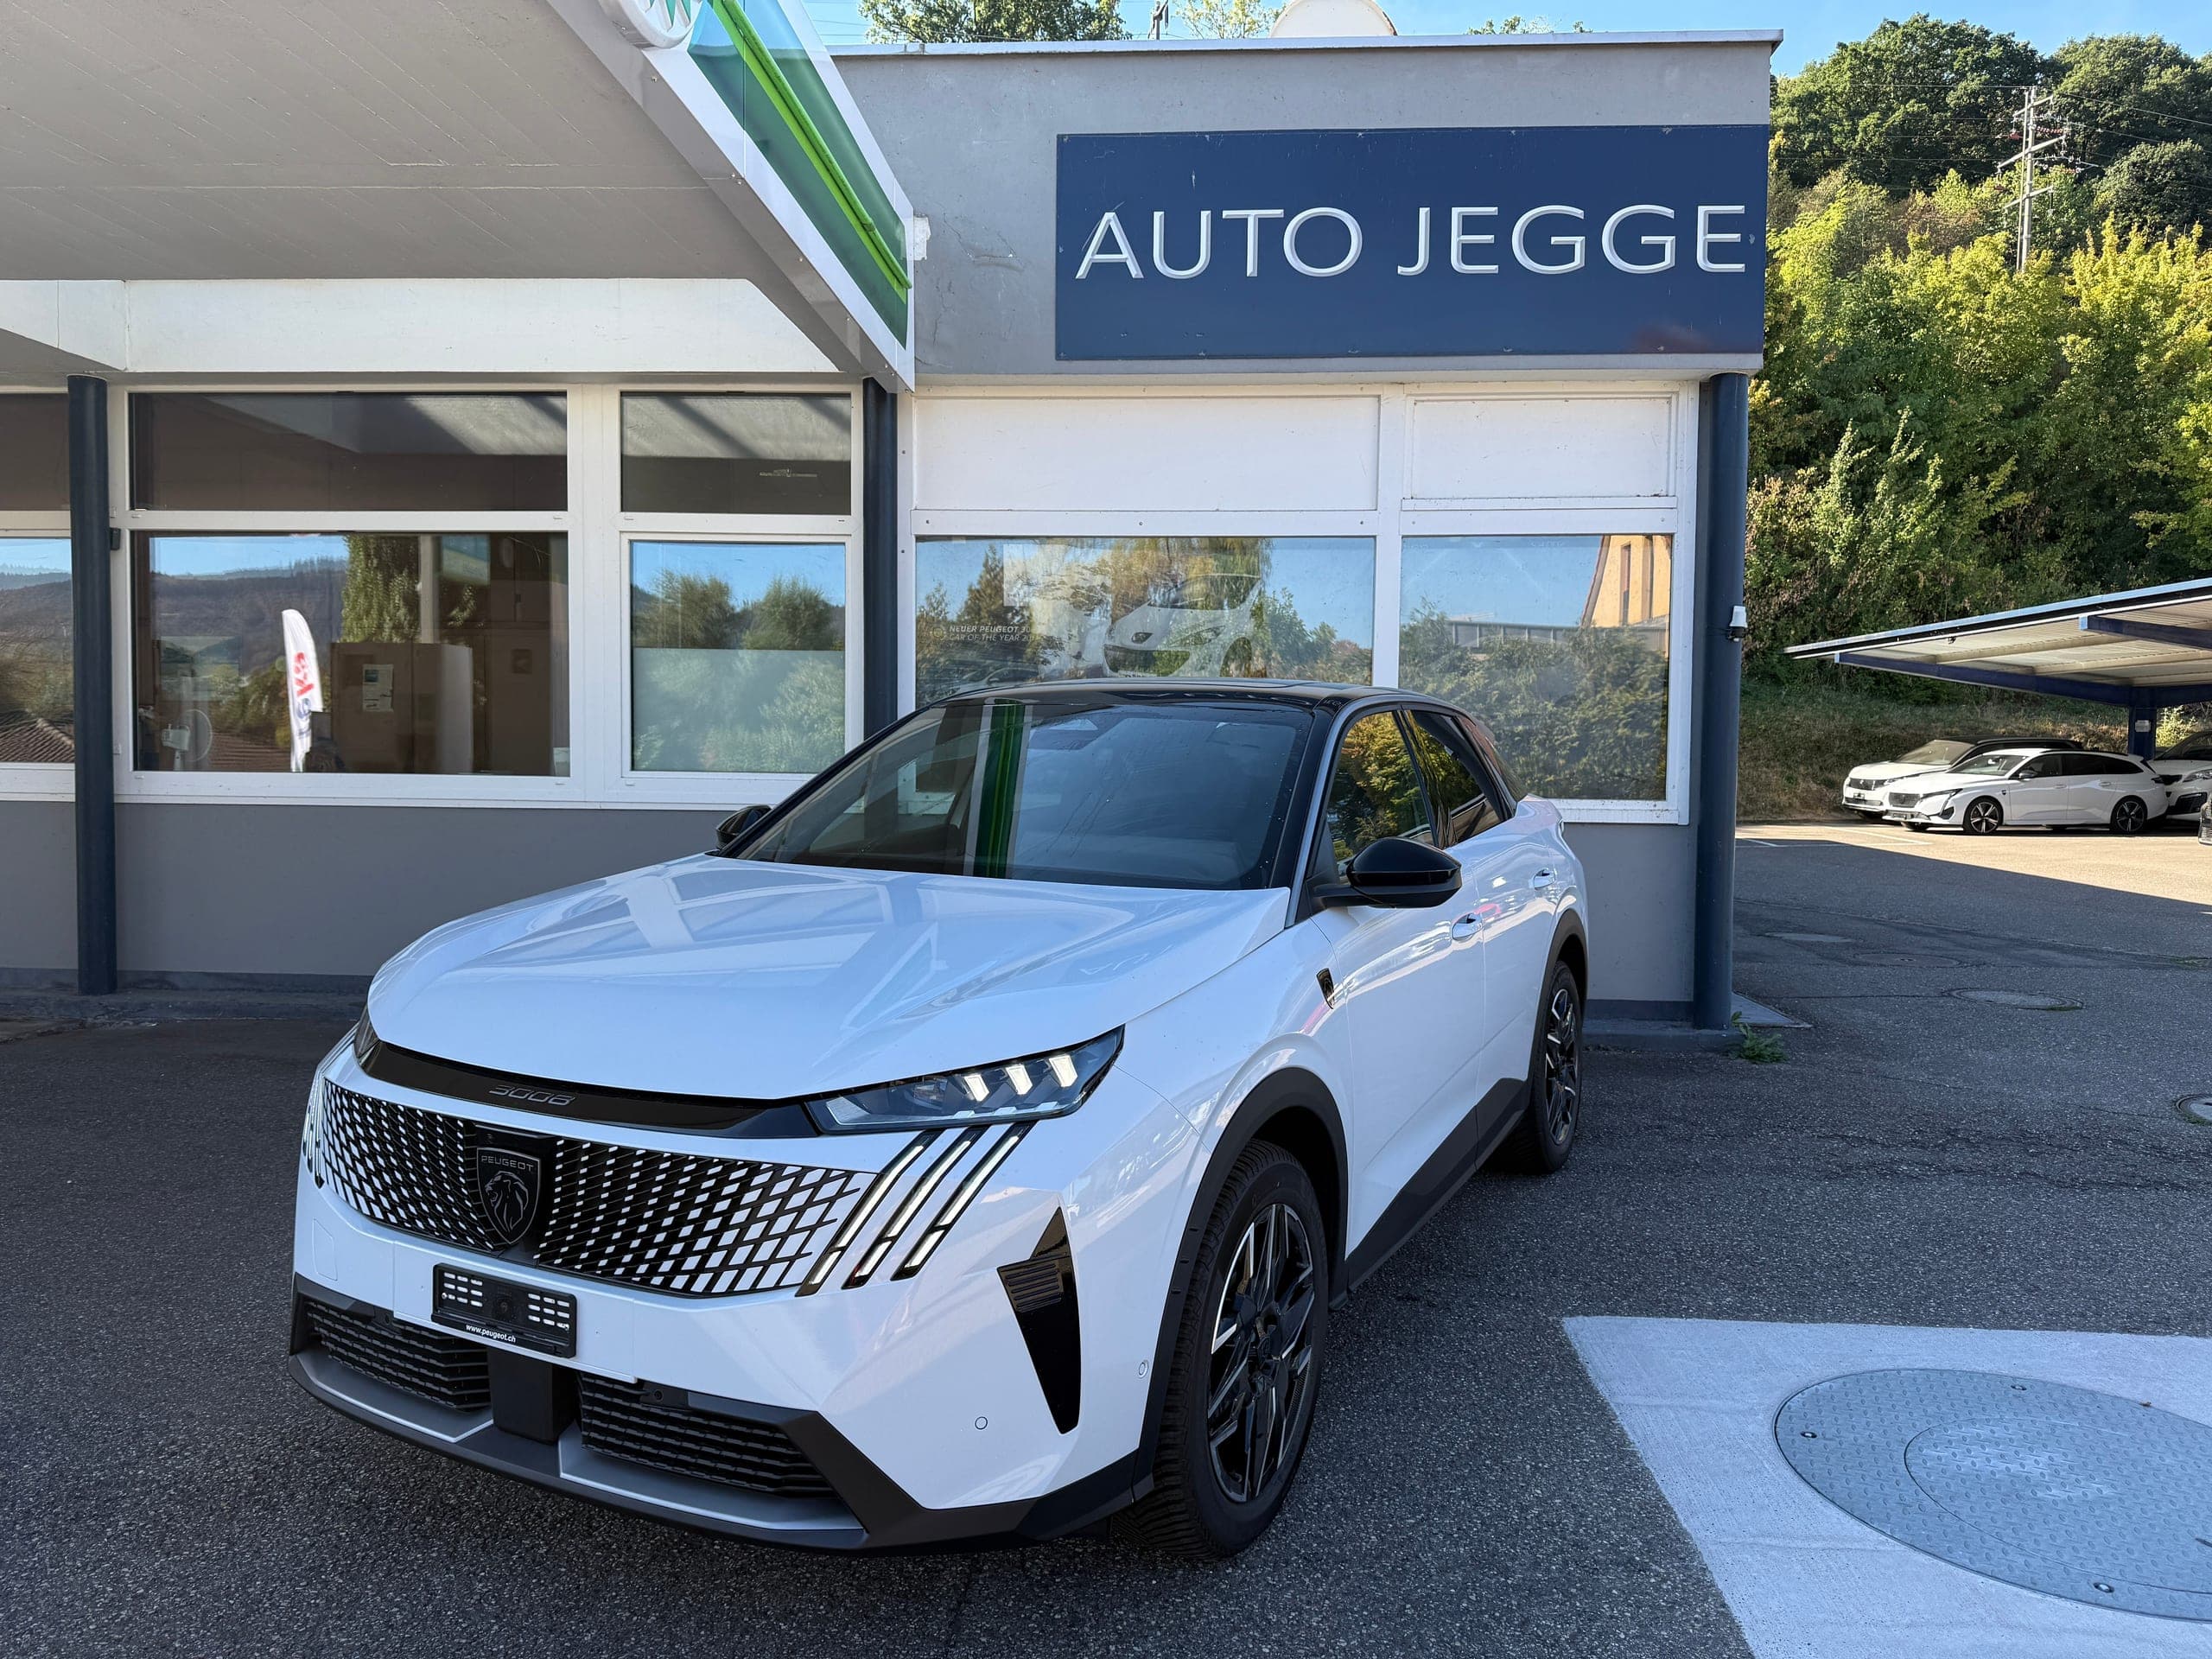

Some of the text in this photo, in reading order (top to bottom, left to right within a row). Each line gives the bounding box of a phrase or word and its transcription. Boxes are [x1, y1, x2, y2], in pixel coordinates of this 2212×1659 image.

[1075, 204, 1747, 280] AUTO JEGGE
[950, 633, 965, 642] CAR
[1000, 634, 1020, 643] YEAR
[489, 1085, 575, 1106] 3008
[480, 1155, 535, 1172] PEUGEOT
[465, 1323, 517, 1344] www.peugeot.ch
